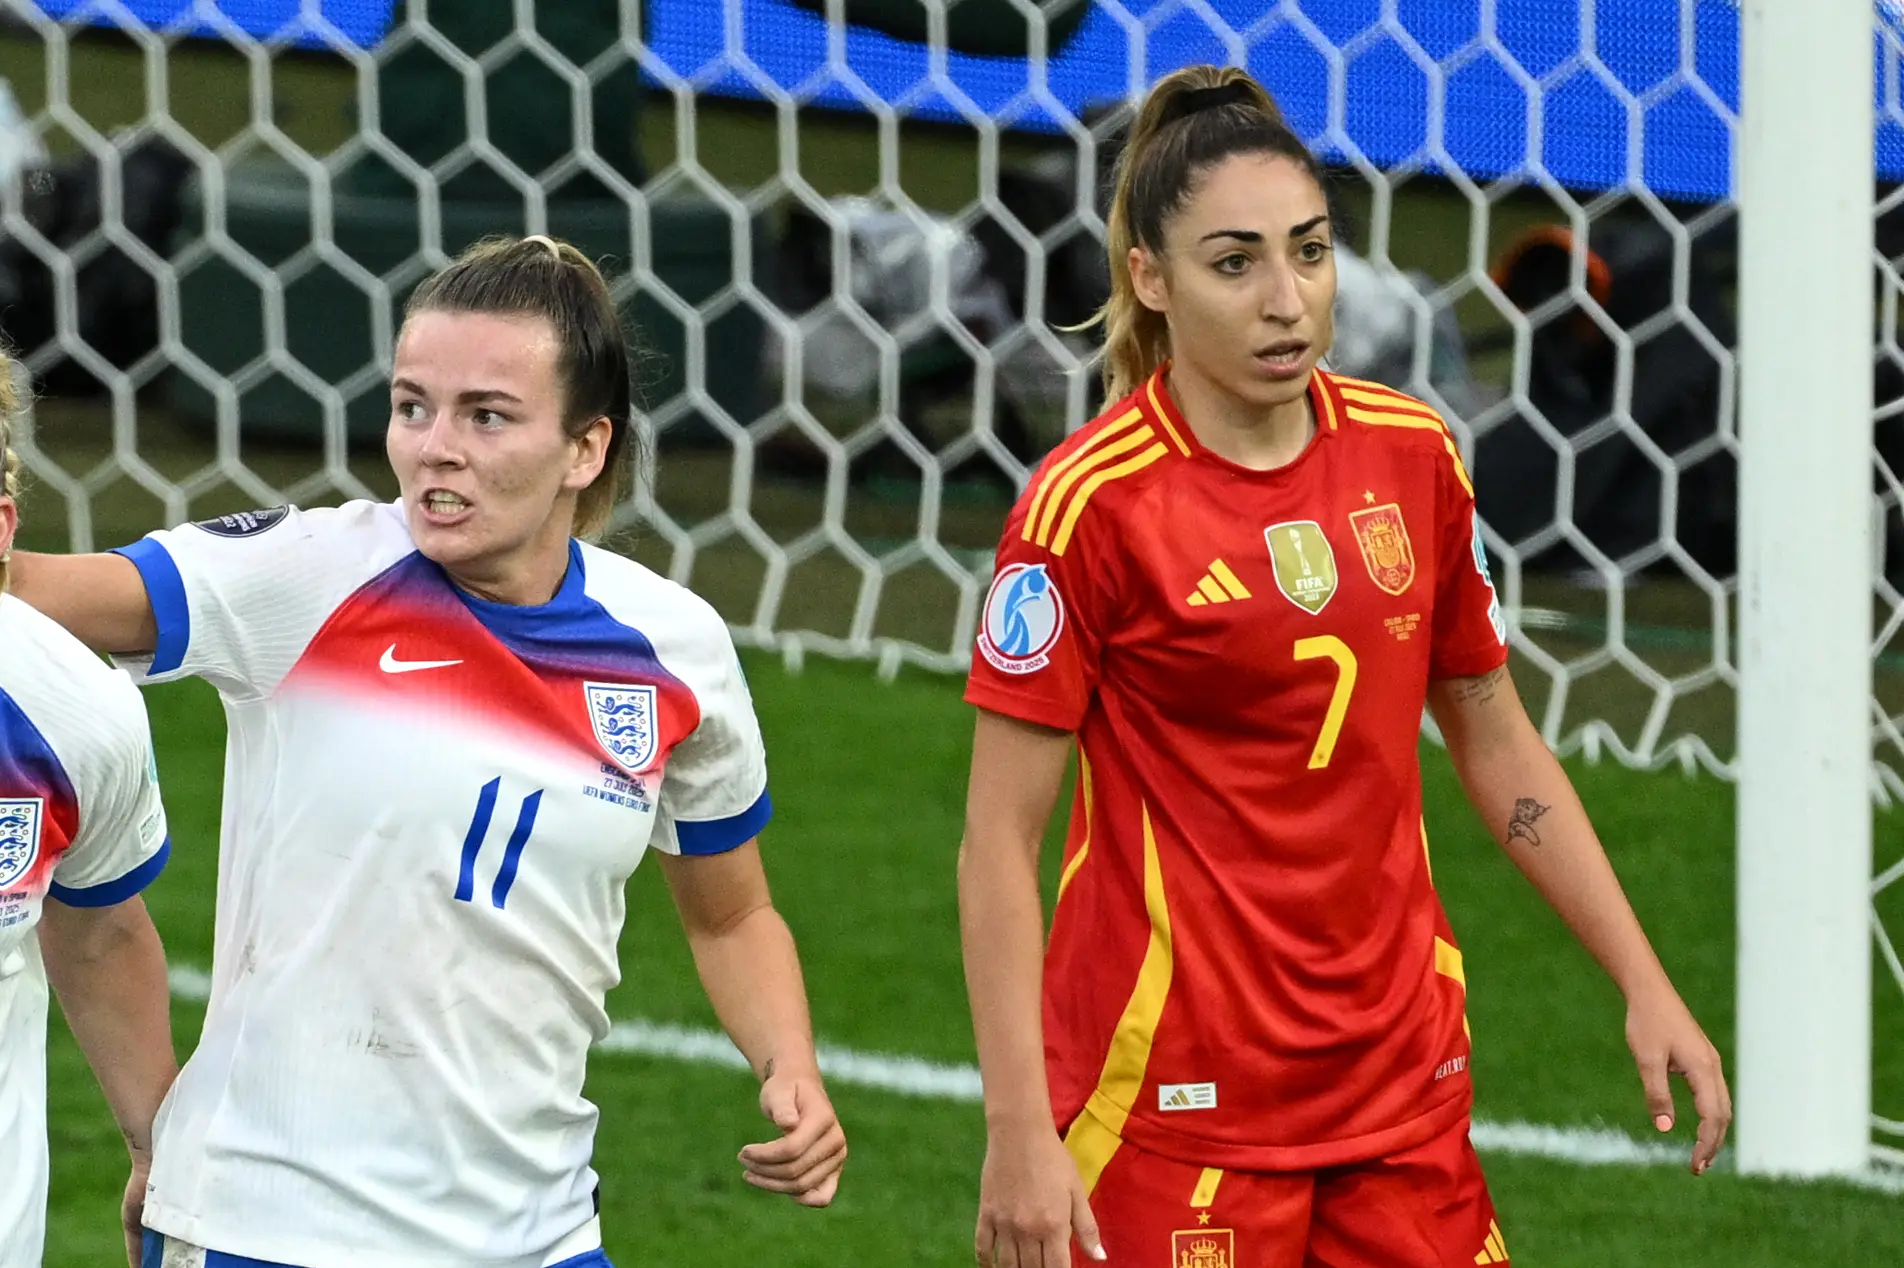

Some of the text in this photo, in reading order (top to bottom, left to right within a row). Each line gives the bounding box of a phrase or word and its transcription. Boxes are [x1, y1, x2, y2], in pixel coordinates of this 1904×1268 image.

[1295, 576, 1323, 591] FIFA
[1294, 634, 1358, 770] 7
[603, 778, 613, 788] 27
[582, 785, 598, 797] UEFA
[454, 776, 544, 910] 11
